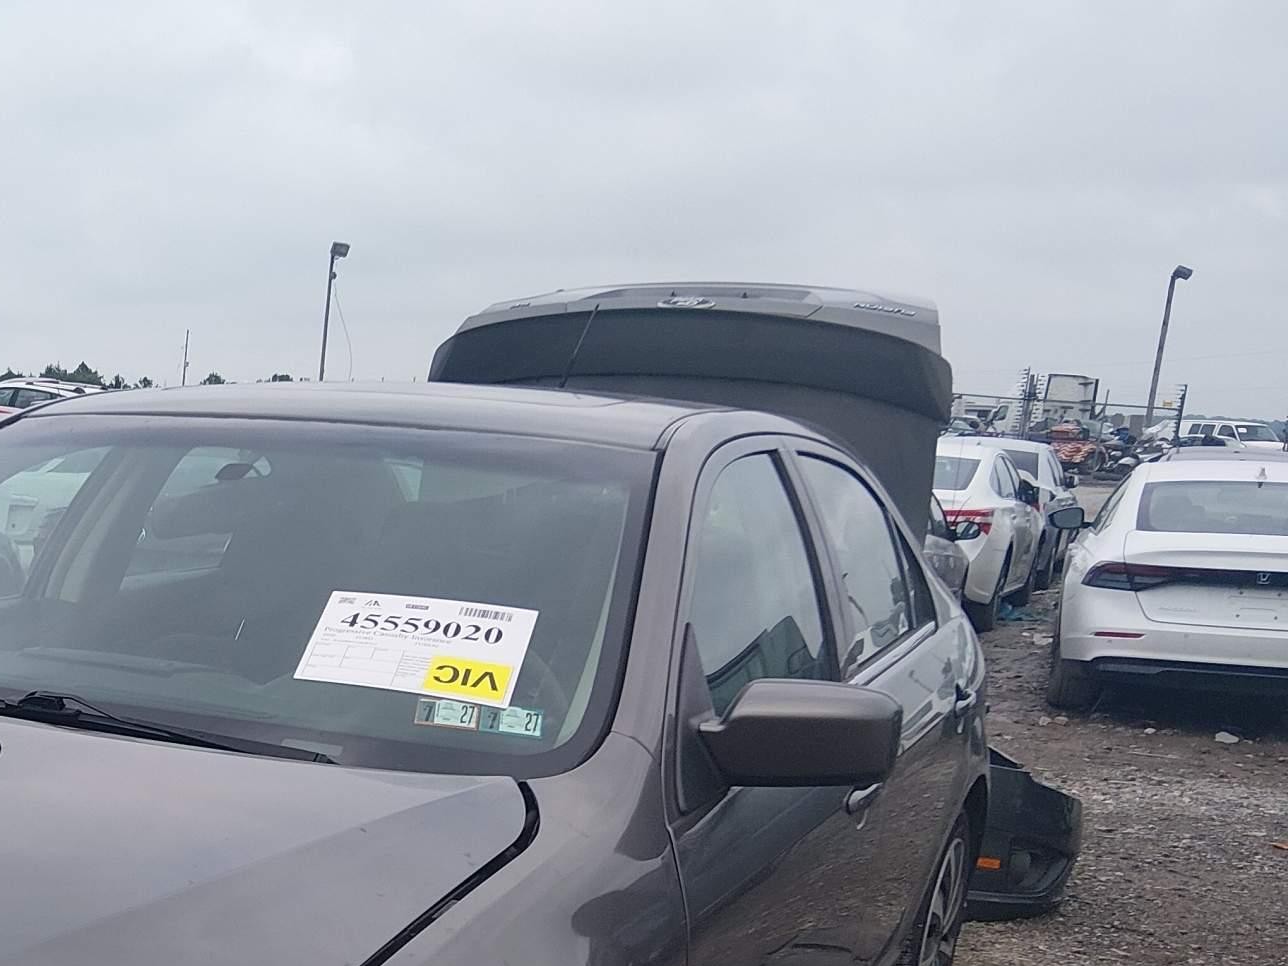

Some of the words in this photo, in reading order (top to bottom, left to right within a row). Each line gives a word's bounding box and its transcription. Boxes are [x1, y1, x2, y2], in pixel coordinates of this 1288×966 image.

[340, 612, 503, 645] 45559020
[433, 665, 498, 691] VIC
[460, 705, 475, 726] 27
[524, 712, 540, 734] 27
